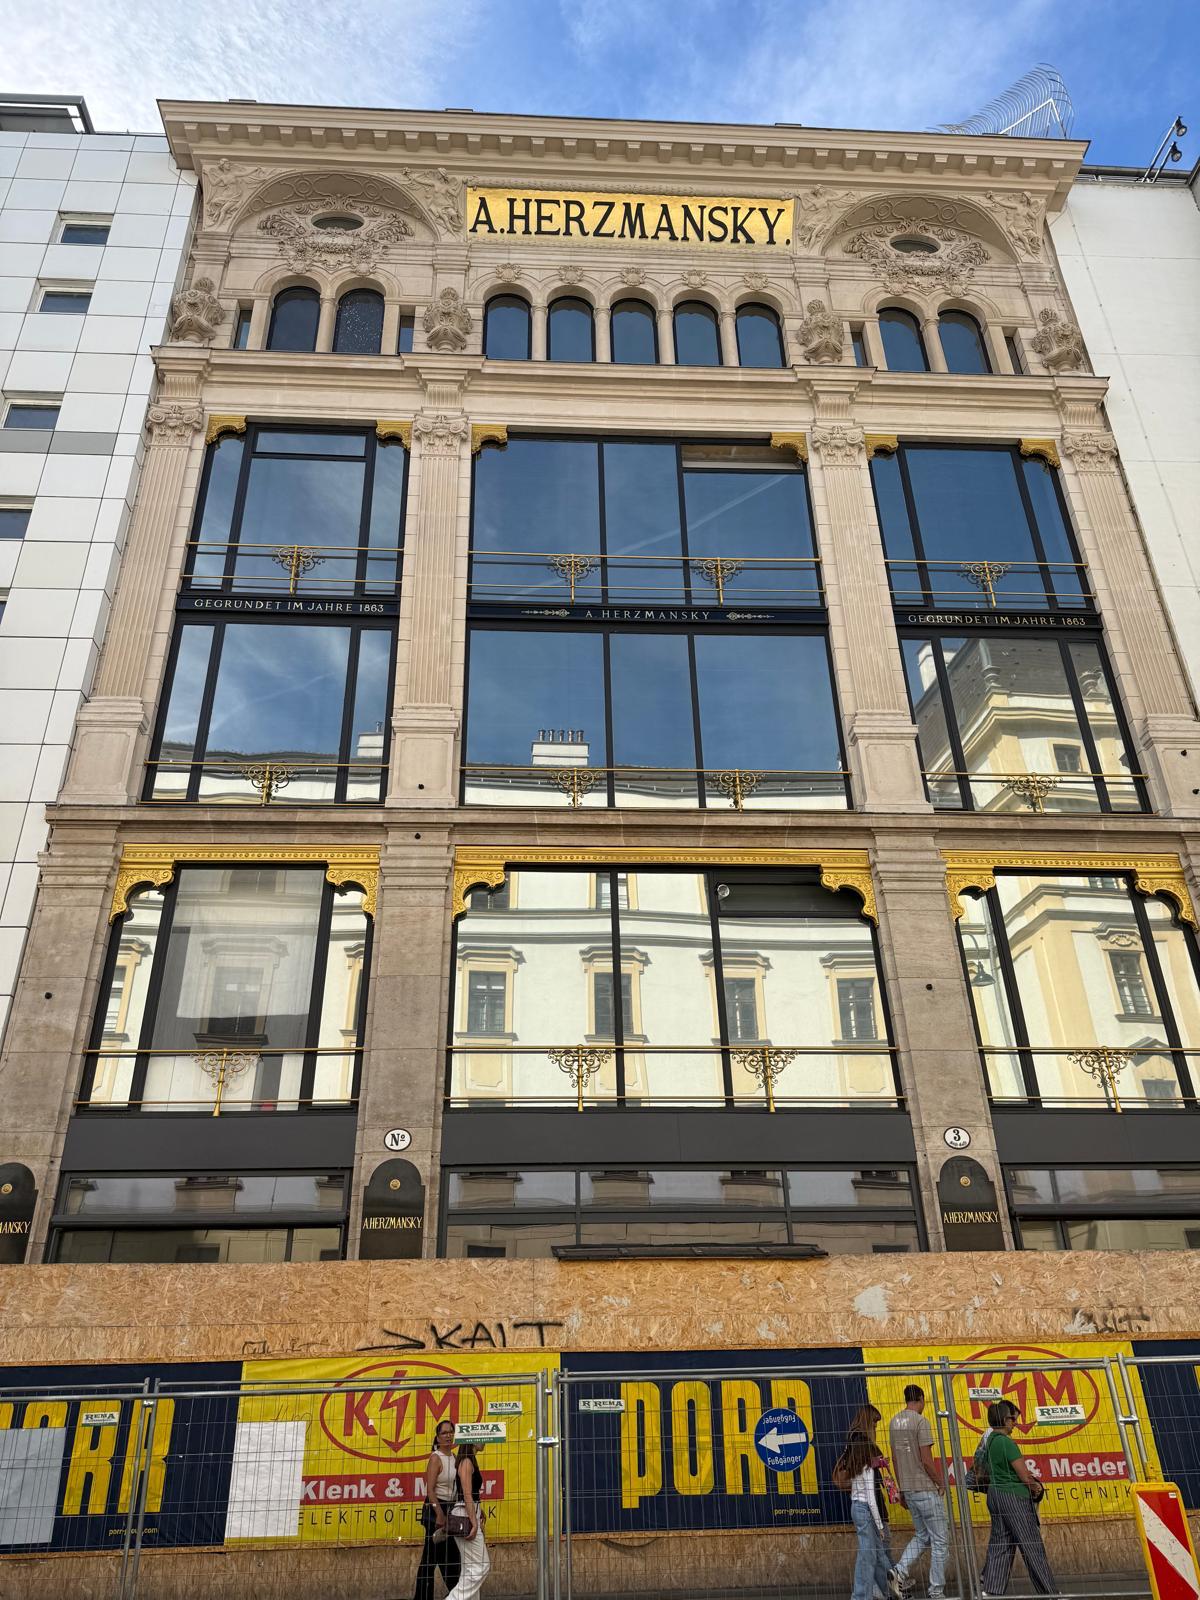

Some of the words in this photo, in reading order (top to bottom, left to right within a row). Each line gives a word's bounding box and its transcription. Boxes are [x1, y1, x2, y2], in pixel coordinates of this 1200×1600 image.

[287, 601, 303, 610] IM
[307, 602, 353, 612] JAHRE
[359, 604, 384, 613] 1863
[602, 610, 710, 620] HERZMANSKY
[994, 616, 1011, 625] IM
[1014, 616, 1057, 626] JAHRE
[1062, 617, 1086, 626] 1863
[952, 1128, 961, 1141] 3
[1039, 1406, 1080, 1416] REMA
[458, 1423, 501, 1433] REMA
[767, 1455, 801, 1466] Fußgänger
[1050, 1457, 1127, 1478] Meder
[301, 1477, 375, 1500] Klenk
[384, 1477, 405, 1498] &
